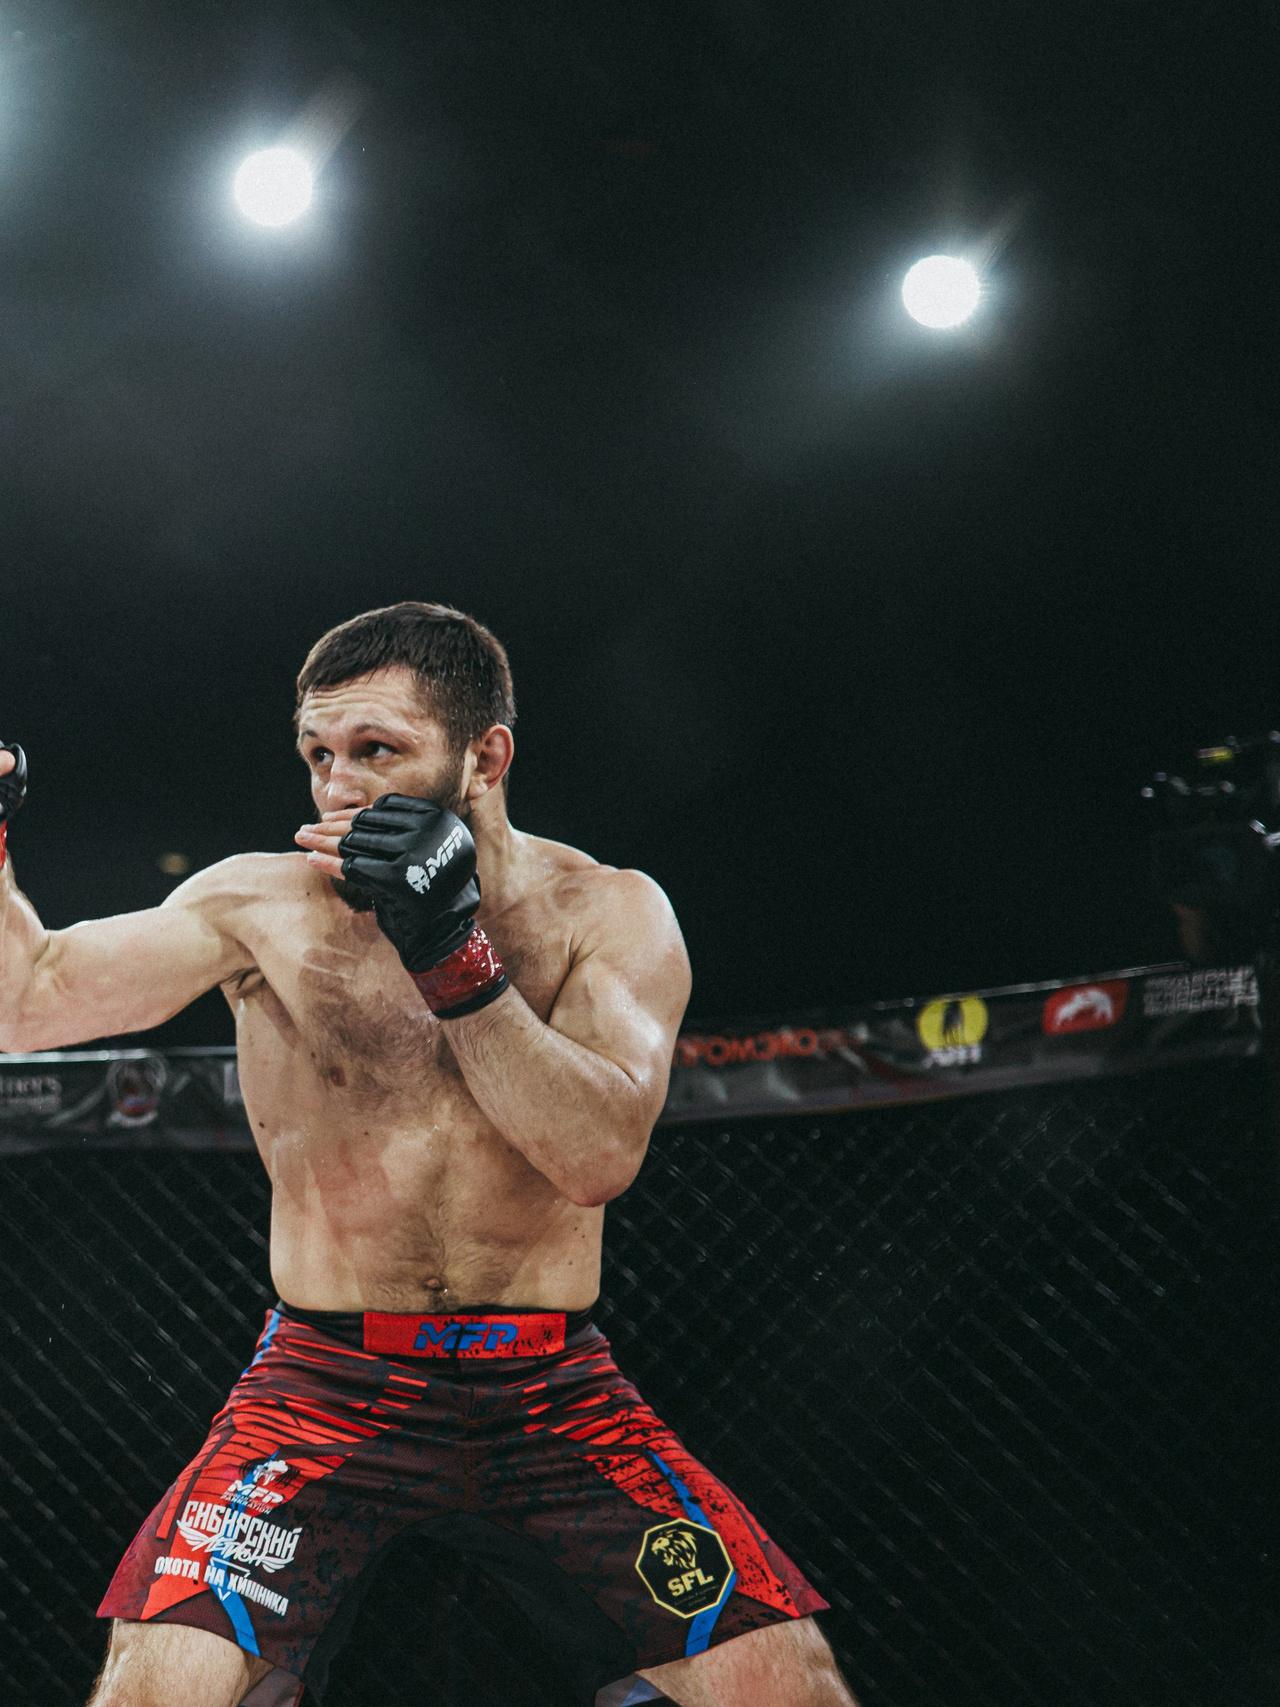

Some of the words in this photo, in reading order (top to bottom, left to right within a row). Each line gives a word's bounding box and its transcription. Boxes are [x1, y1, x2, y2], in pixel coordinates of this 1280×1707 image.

[425, 825, 463, 879] MFP
[413, 1322, 518, 1351] MFP
[227, 1479, 284, 1504] MFP
[181, 1500, 302, 1559] СИБИРСКИЙ
[154, 1556, 200, 1580] ОХОТА
[204, 1564, 225, 1588] НА
[228, 1574, 289, 1616] ХИЩНИКА
[667, 1568, 714, 1597] SFL
